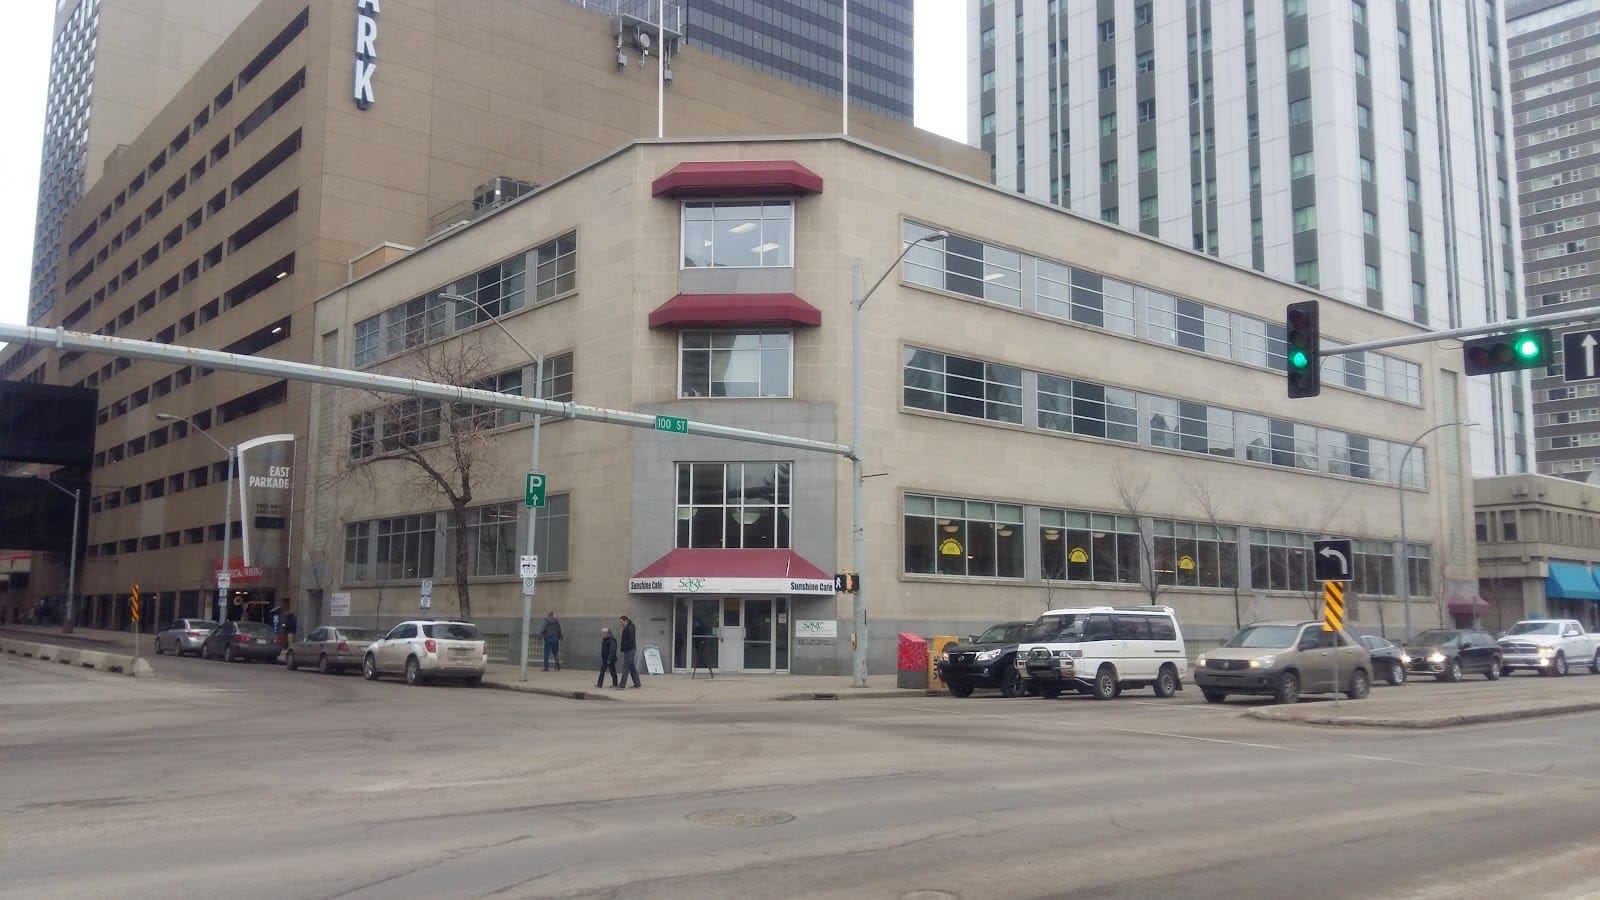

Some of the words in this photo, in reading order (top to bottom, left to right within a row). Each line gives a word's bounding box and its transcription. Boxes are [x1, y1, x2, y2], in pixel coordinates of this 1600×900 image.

[354, 0, 380, 103] RK
[658, 418, 671, 430] 100
[676, 420, 686, 431] ST
[269, 466, 290, 478] EAST
[249, 476, 290, 489] PARKADE
[529, 476, 543, 494] P
[790, 581, 819, 592] Sunshine
